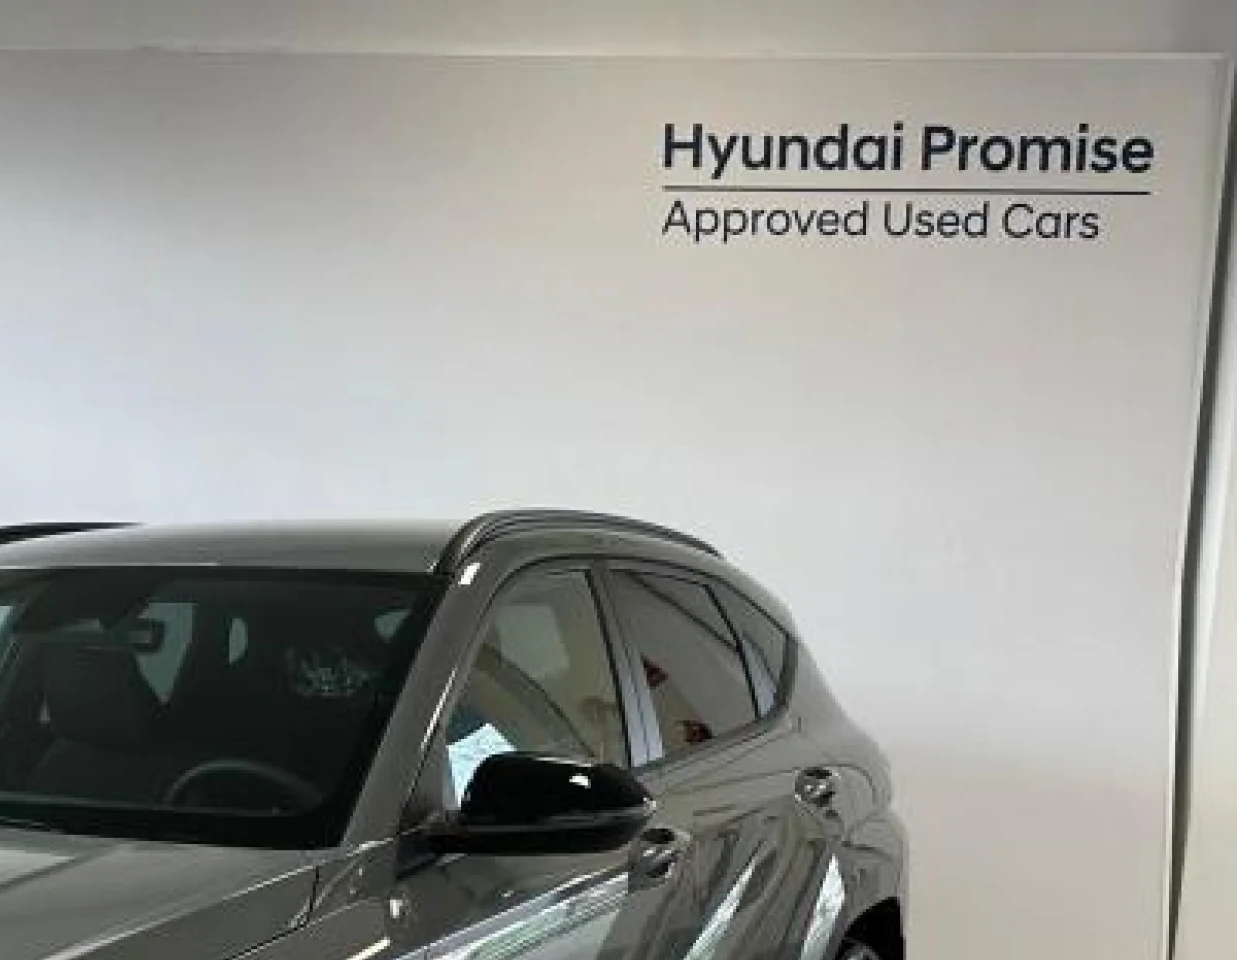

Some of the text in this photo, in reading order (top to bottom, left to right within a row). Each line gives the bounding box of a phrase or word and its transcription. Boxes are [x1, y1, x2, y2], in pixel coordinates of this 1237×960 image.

[664, 121, 1155, 179] Hyundai Promise
[663, 201, 1100, 242] Approved Used Cars
